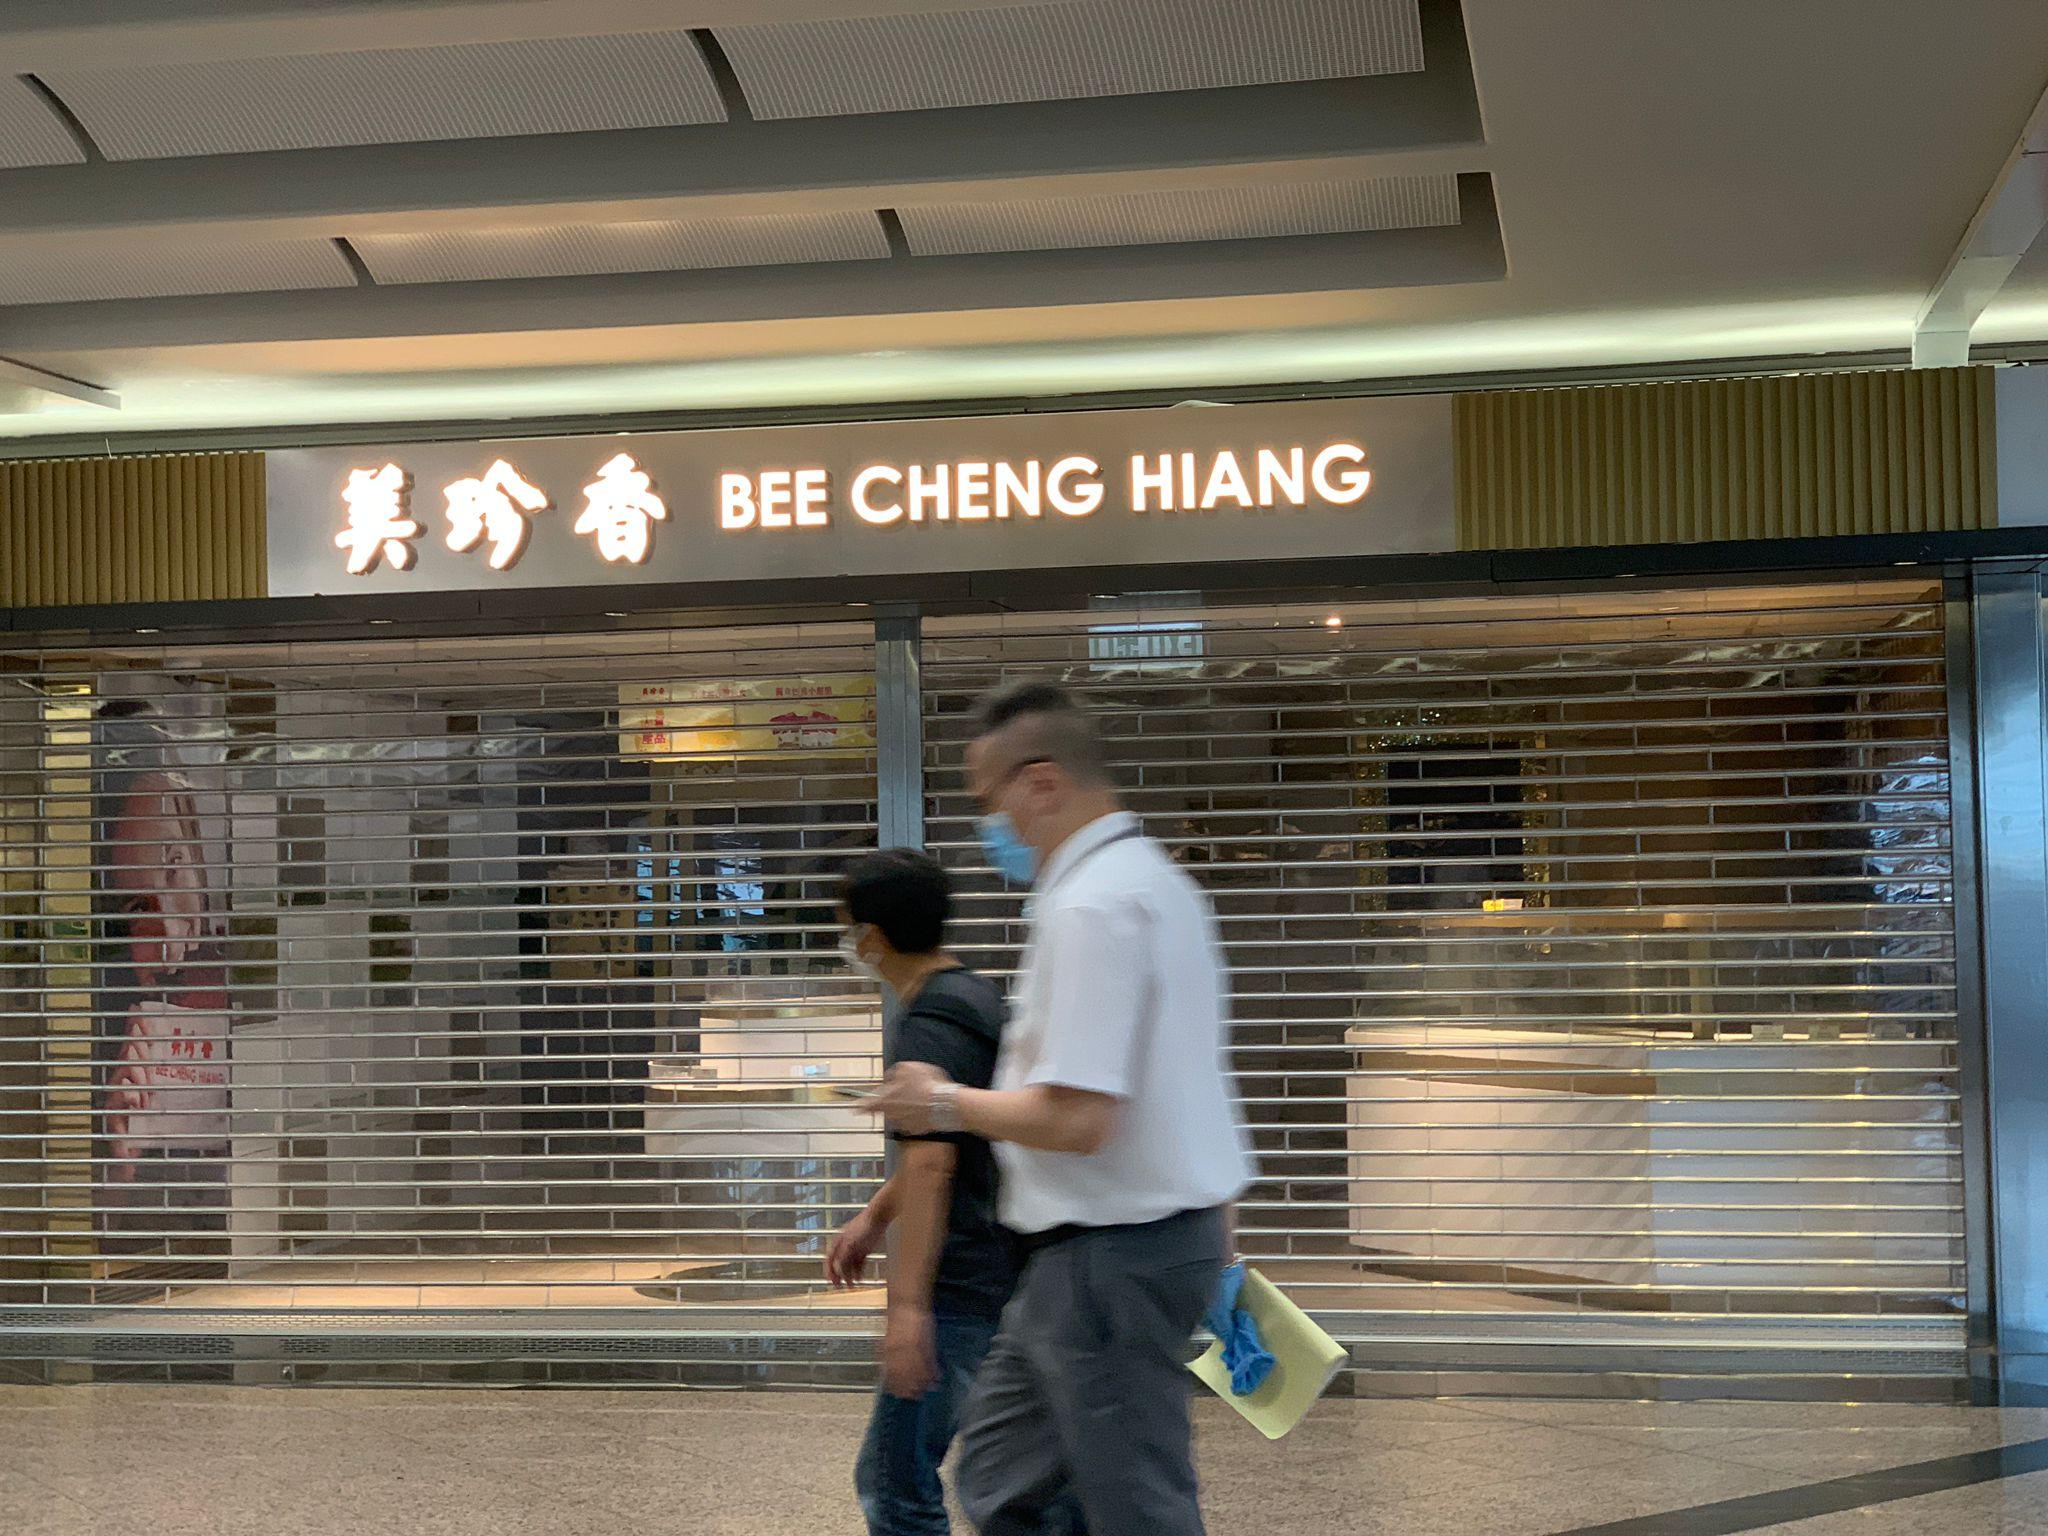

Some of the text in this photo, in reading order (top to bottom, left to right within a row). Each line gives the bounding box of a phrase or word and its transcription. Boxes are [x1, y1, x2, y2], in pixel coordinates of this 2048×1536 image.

[334, 453, 667, 574] 美珍香
[720, 443, 1371, 530] BEE CHENG HIANG
